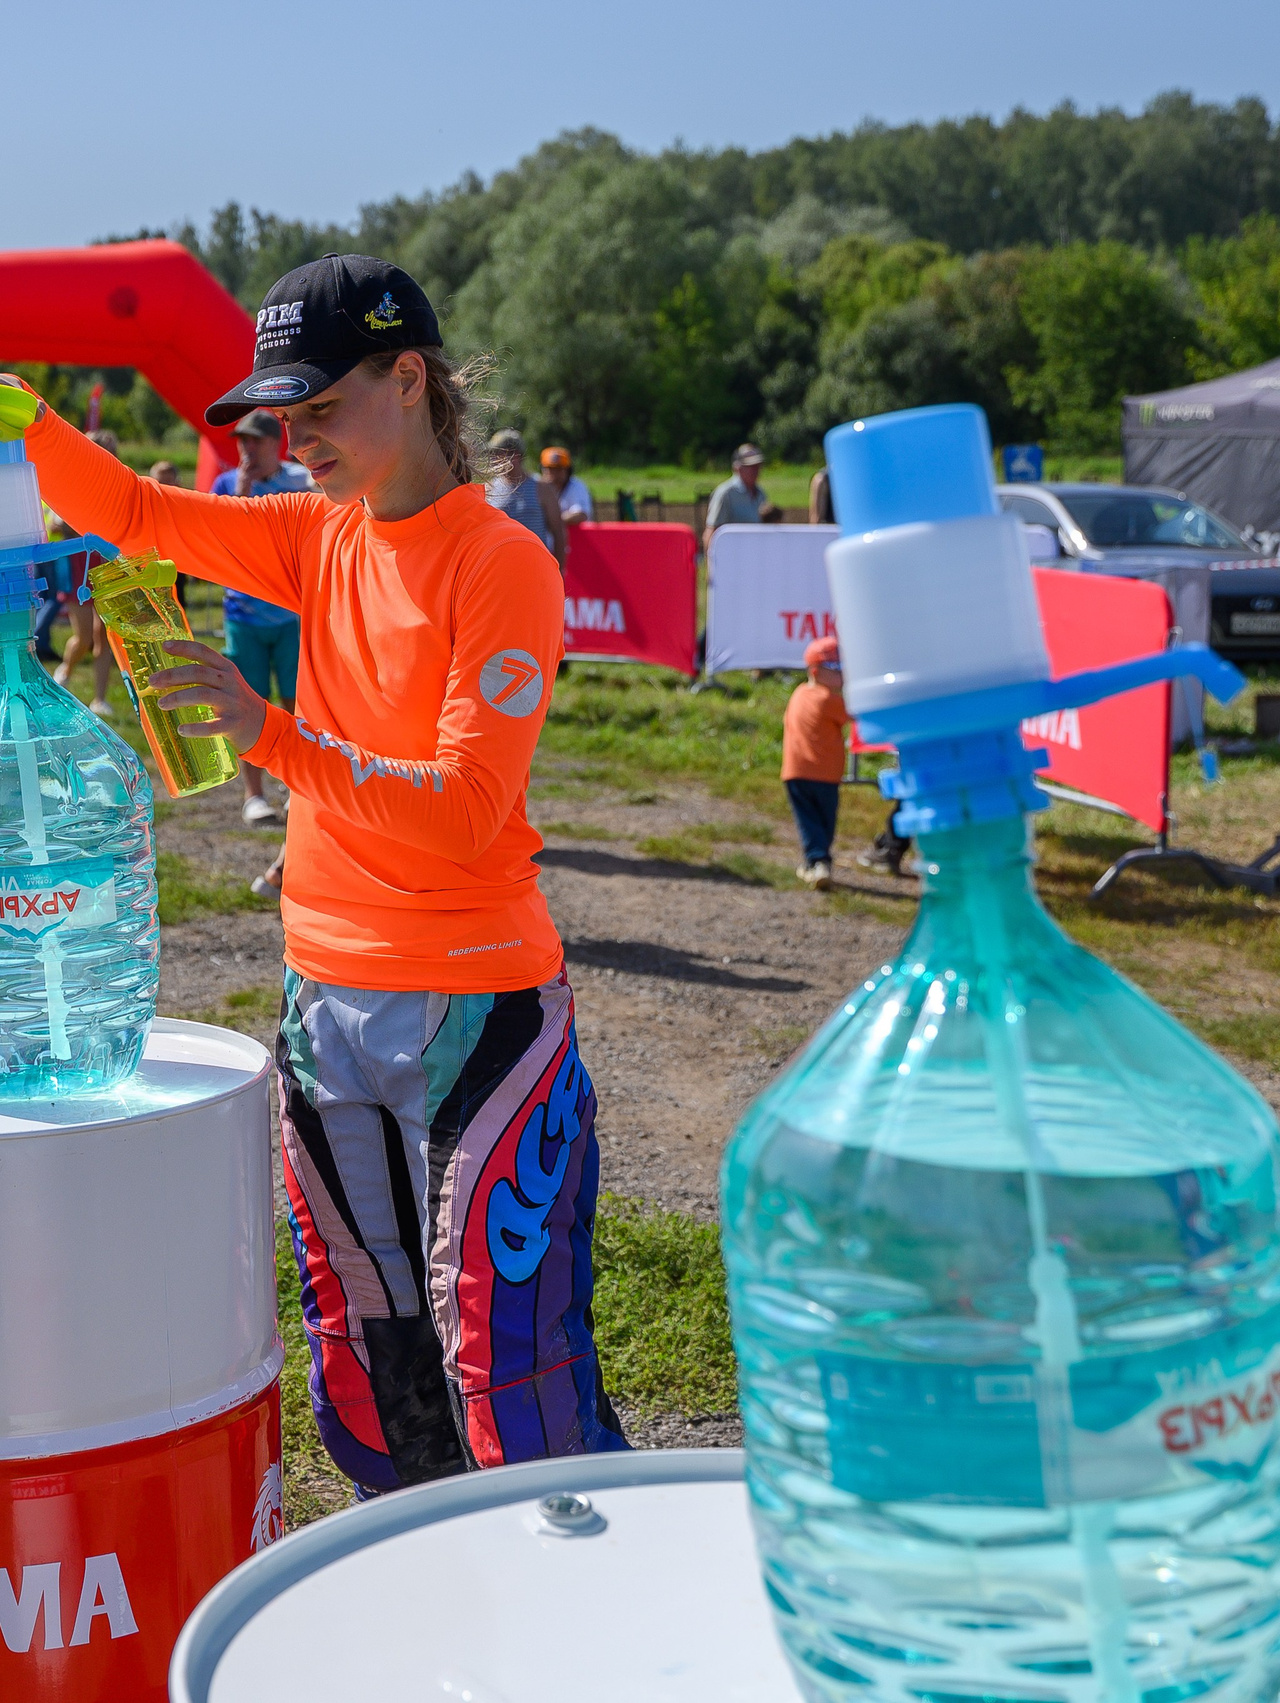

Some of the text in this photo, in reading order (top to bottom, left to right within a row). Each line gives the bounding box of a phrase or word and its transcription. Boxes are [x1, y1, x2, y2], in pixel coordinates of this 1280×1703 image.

[260, 338, 291, 351] SCHOOL
[447, 939, 522, 957] REDEFINING LIMITS
